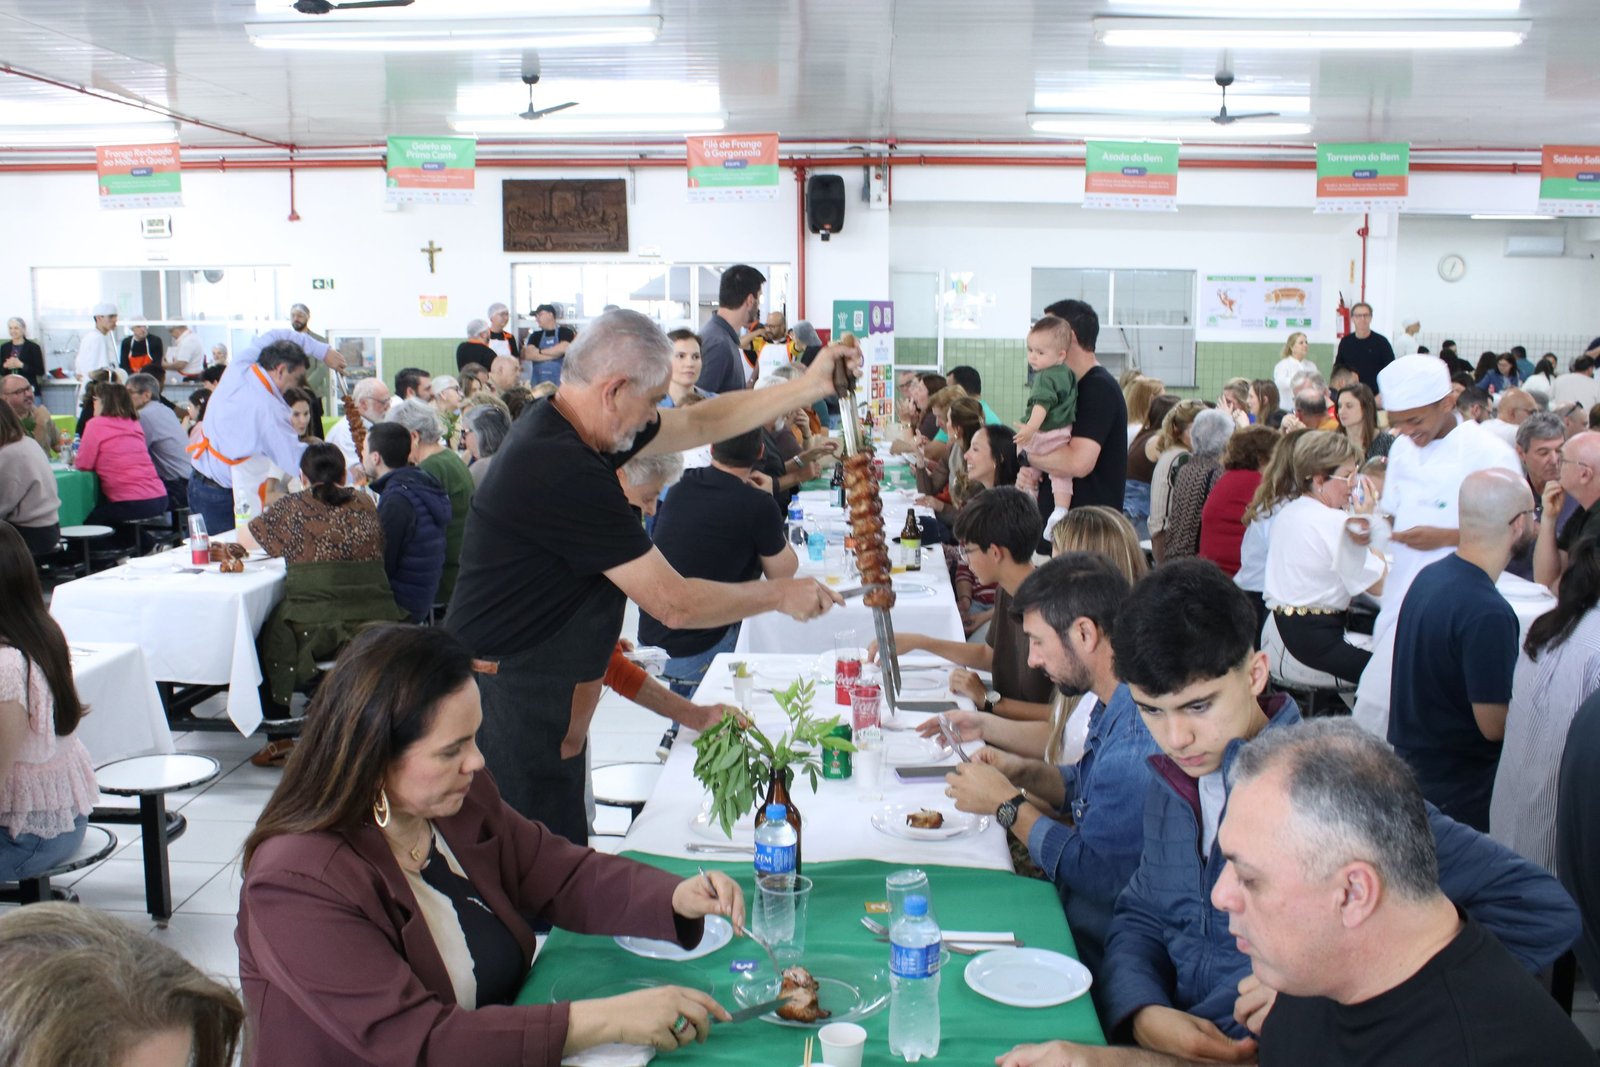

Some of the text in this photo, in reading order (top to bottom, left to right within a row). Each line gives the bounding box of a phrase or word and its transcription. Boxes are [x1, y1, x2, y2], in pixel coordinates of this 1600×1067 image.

[412, 141, 439, 151] Galeto
[720, 140, 730, 148] de
[731, 140, 762, 150] Frango
[406, 150, 457, 160] Primo Canto
[712, 149, 761, 159] Gorgonzola
[1326, 153, 1400, 162] Torresmo do Bem
